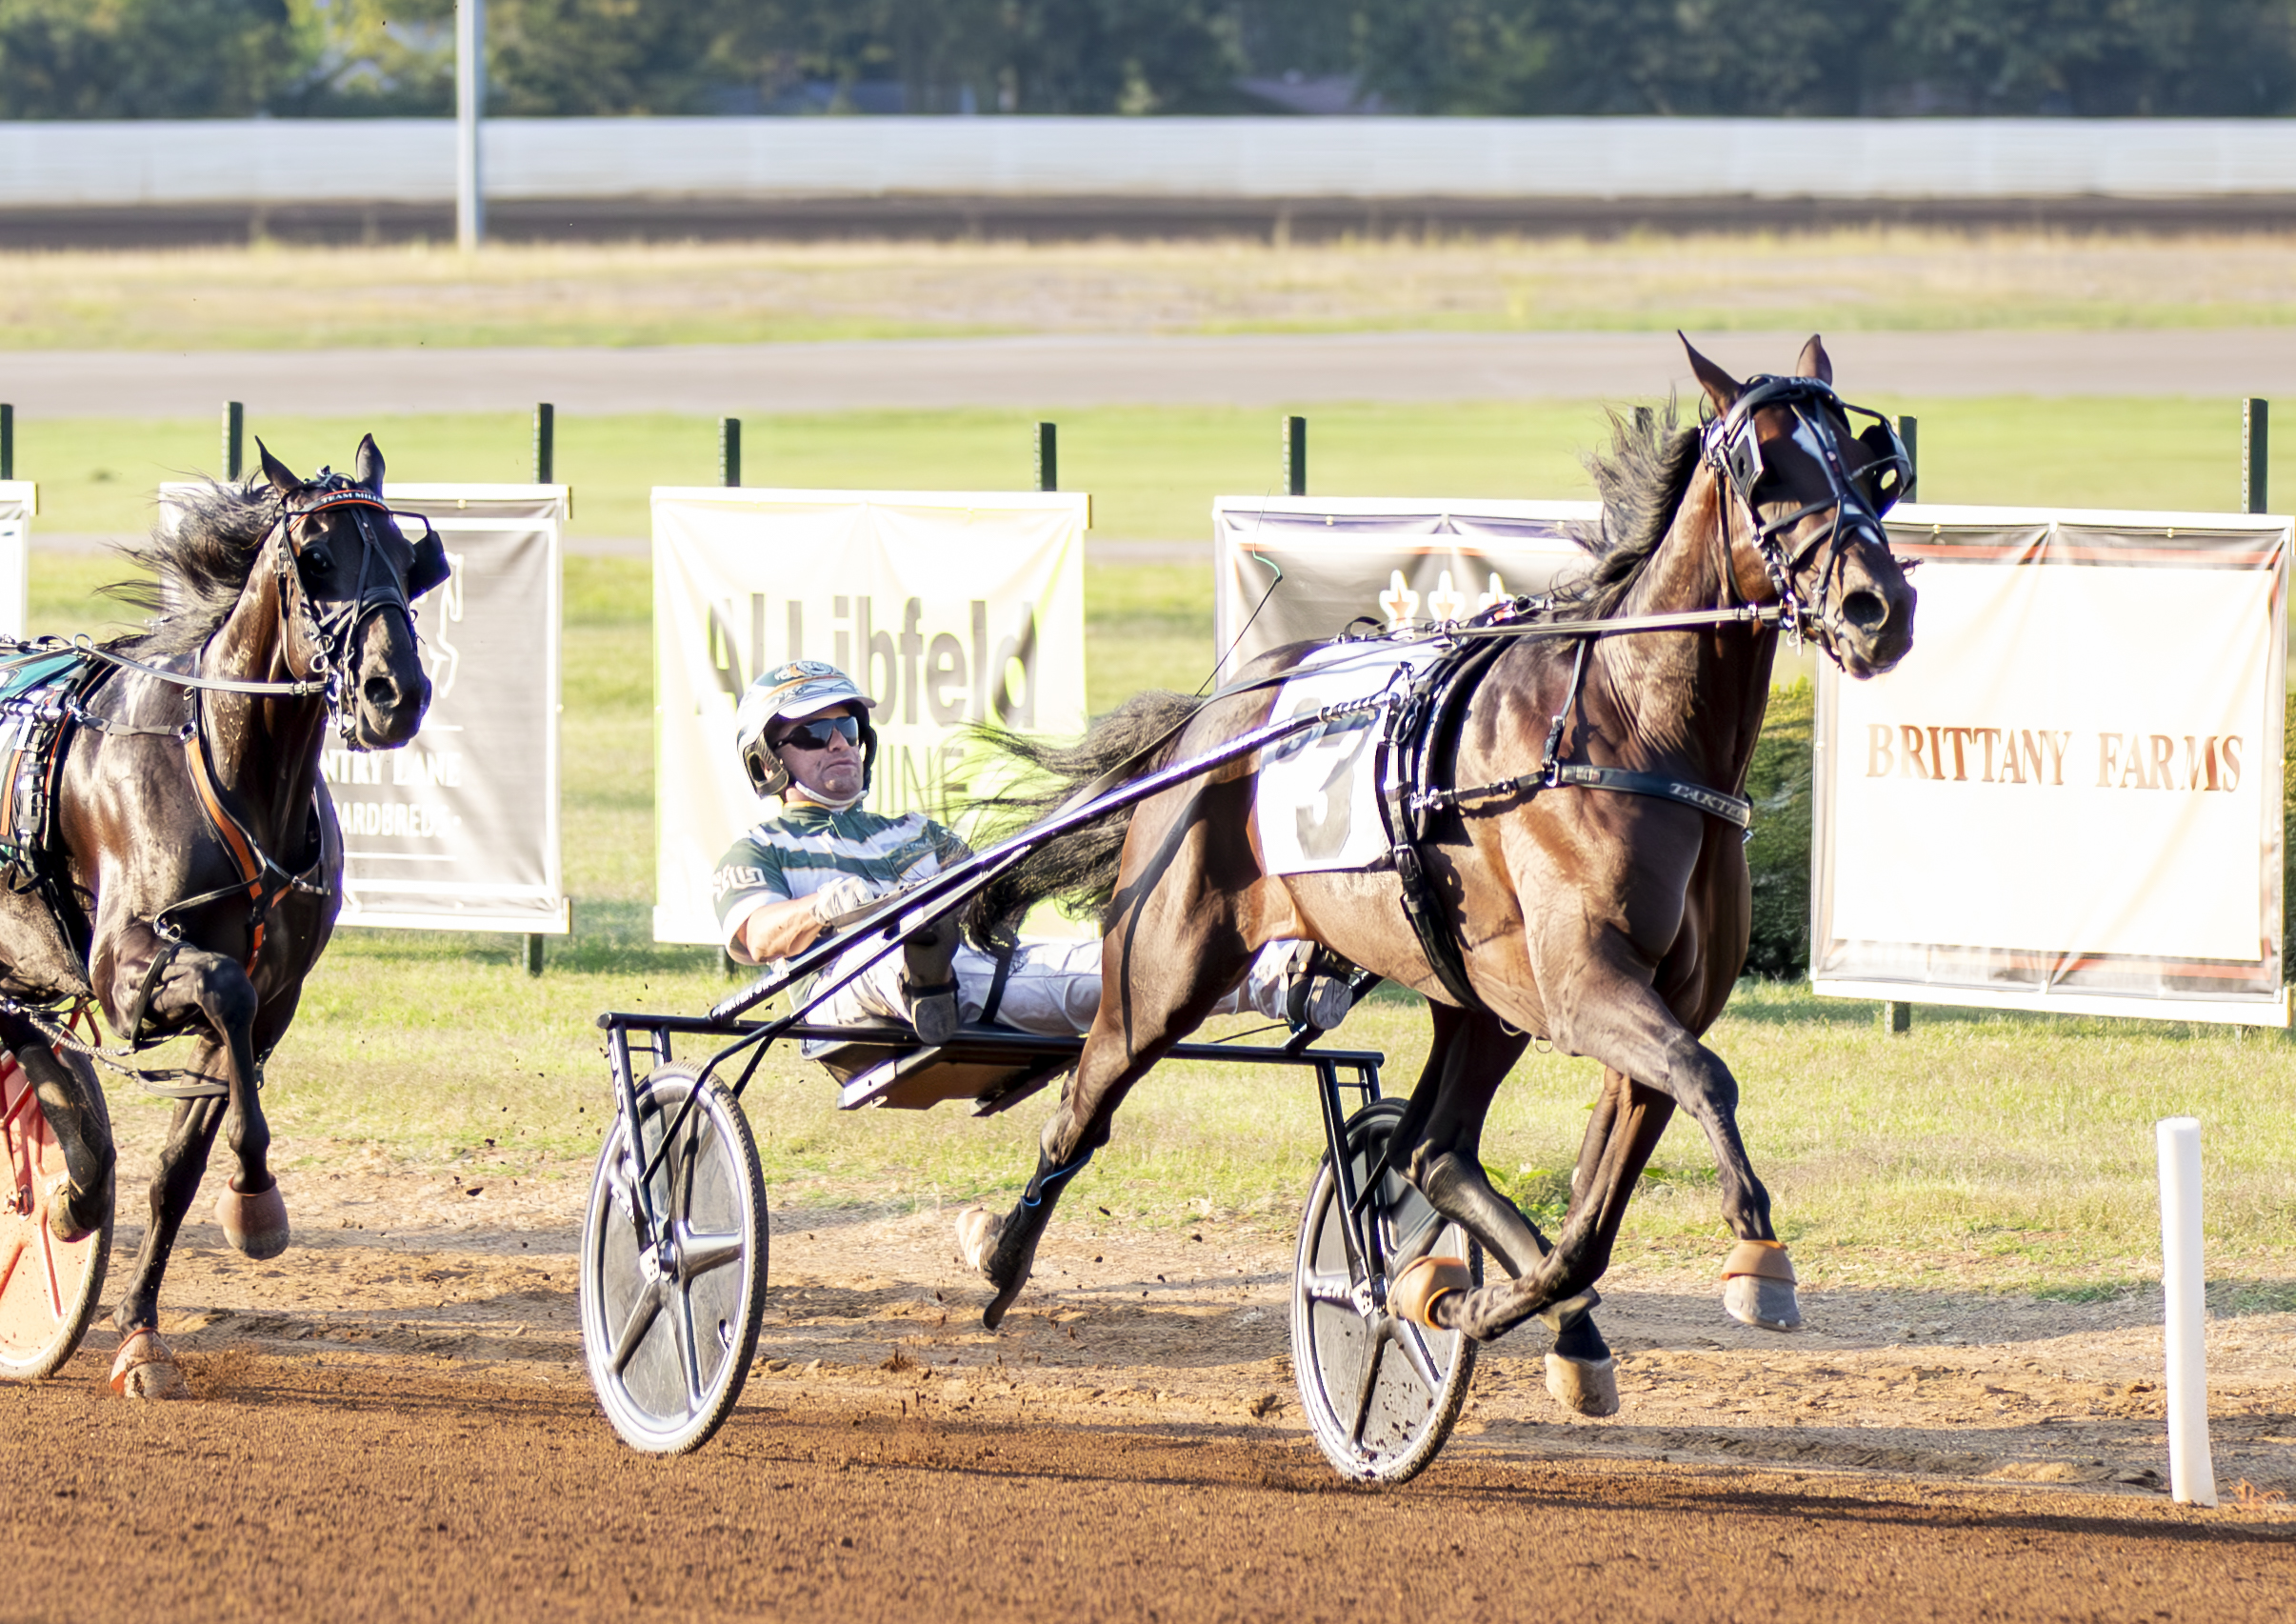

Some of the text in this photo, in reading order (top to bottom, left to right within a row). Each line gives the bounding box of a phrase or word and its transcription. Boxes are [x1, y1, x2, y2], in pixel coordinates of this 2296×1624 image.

[392, 747, 463, 788] LANE
[1277, 696, 1371, 861] 3
[1866, 723, 2245, 793] BRITTANY FARMS
